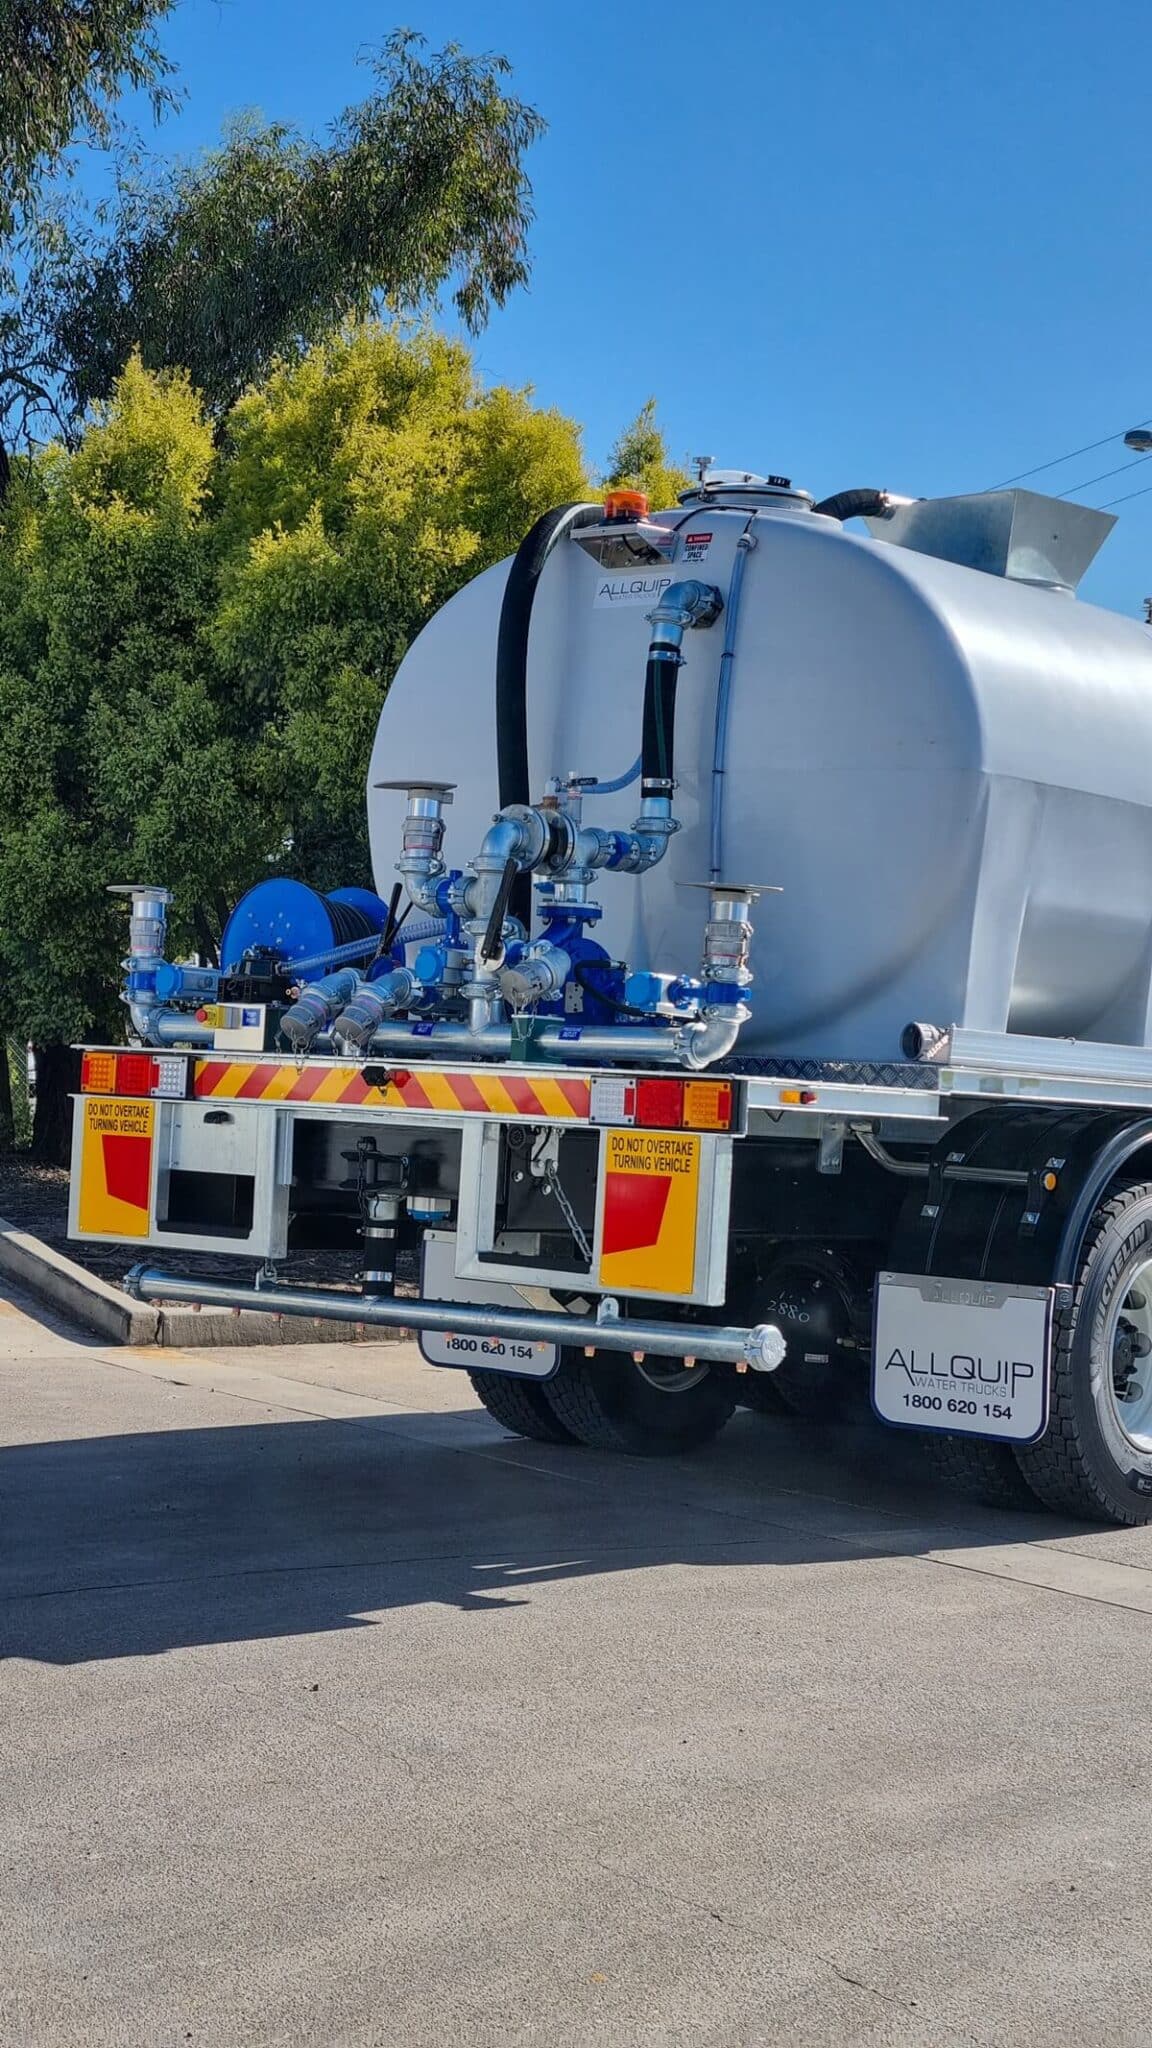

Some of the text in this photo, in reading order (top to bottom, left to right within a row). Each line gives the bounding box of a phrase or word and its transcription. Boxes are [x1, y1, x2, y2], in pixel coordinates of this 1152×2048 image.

[599, 579, 671, 601] ALLQUIP
[88, 1103, 149, 1118] DO NOT OVERTAKE
[90, 1117, 148, 1133] TURNING VEHICLE
[612, 1136, 693, 1156] DO NOT OVERTAKE
[613, 1154, 690, 1173] TURNING VEHICLE
[510, 1345, 534, 1360] 154
[884, 1348, 1034, 1399] ALLQUIP
[914, 1377, 1007, 1398] WATER TRUCKS
[903, 1393, 1013, 1420] 1800 620 154
